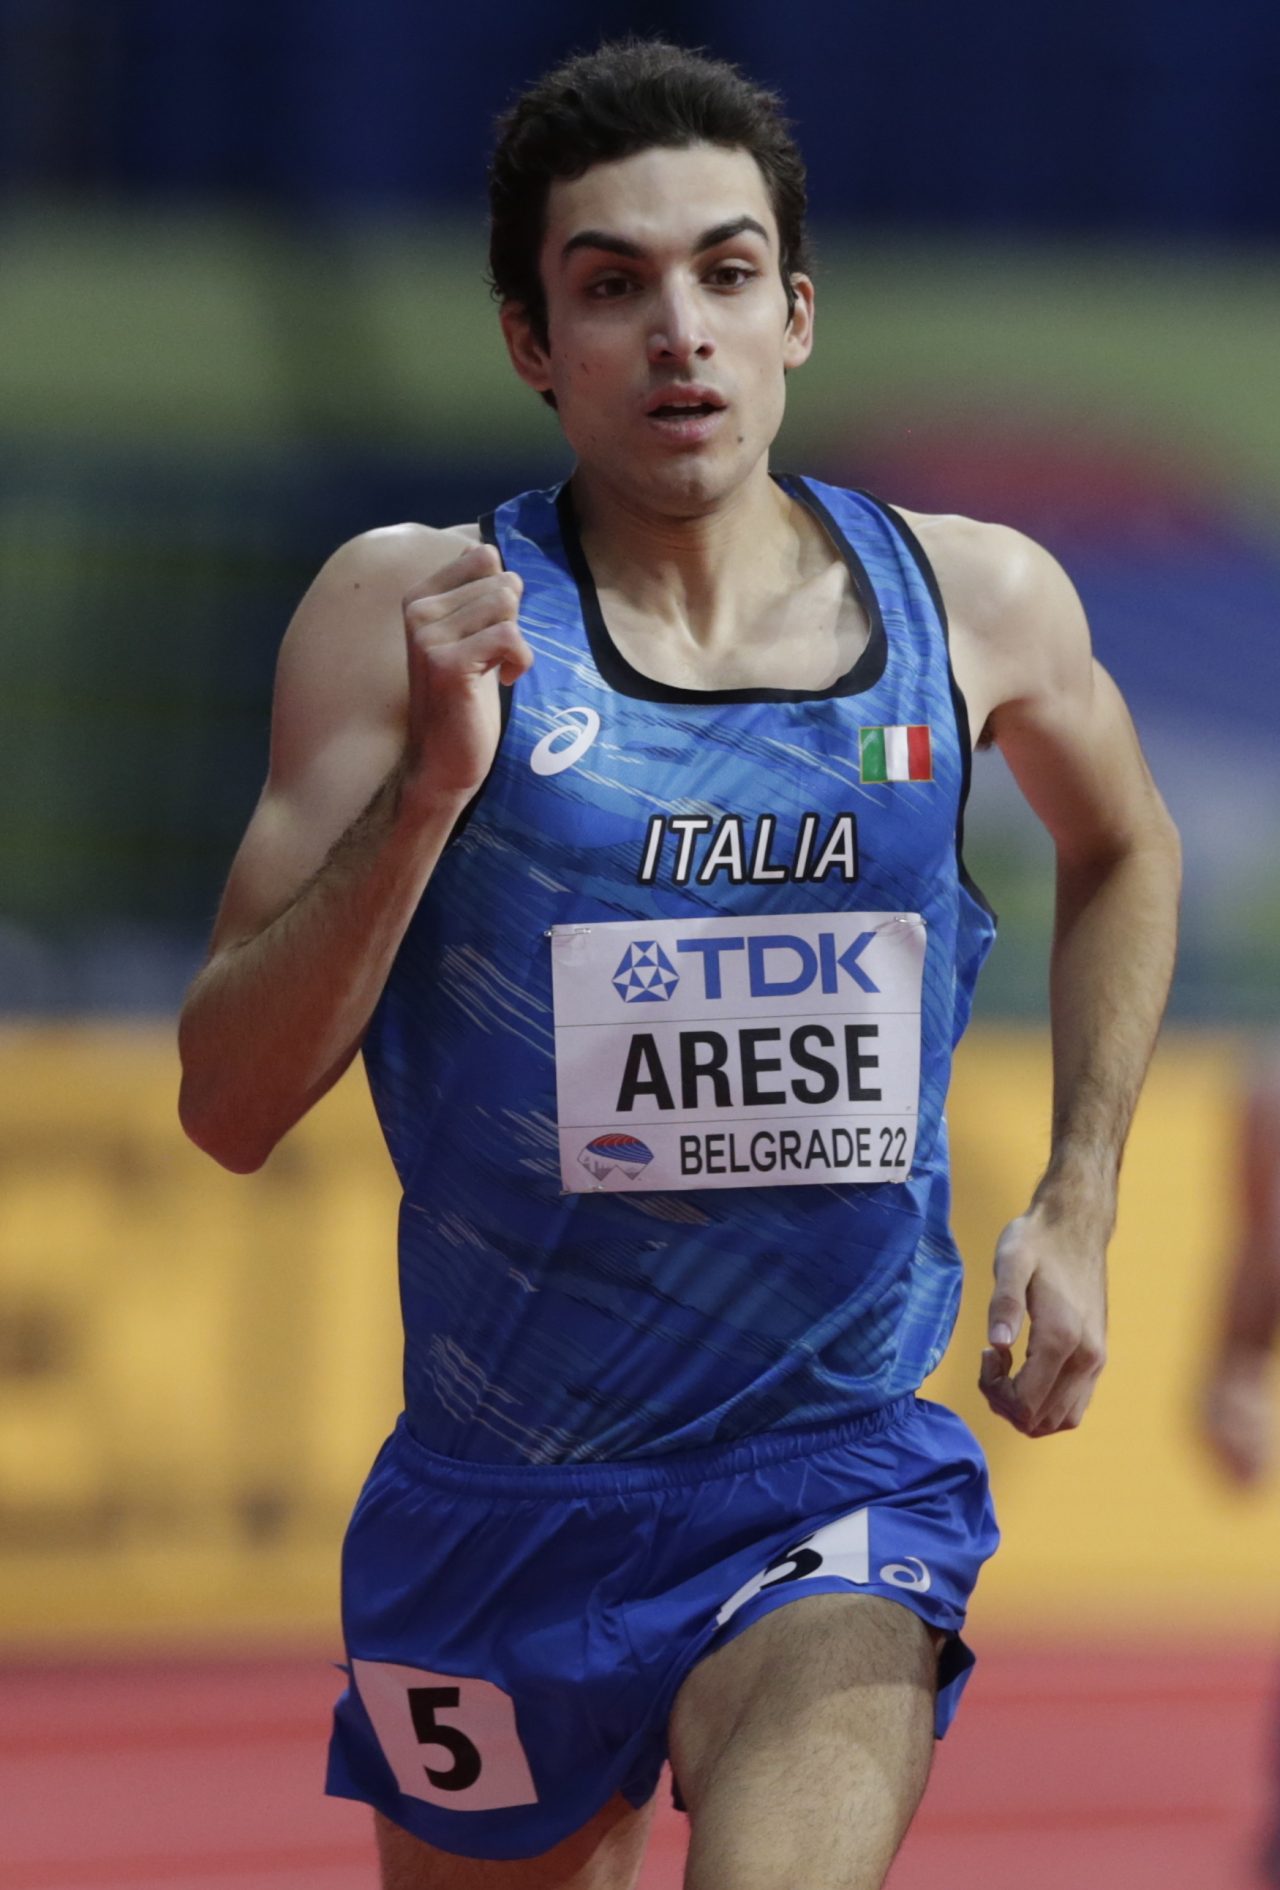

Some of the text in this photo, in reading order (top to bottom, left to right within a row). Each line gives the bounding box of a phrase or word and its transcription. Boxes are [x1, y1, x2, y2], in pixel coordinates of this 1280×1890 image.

[639, 814, 858, 884] ITALIA
[677, 932, 881, 999] TDK
[615, 1024, 882, 1112] ARESE
[680, 1127, 908, 1175] BELGRADE 22
[407, 1686, 482, 1792] 5
